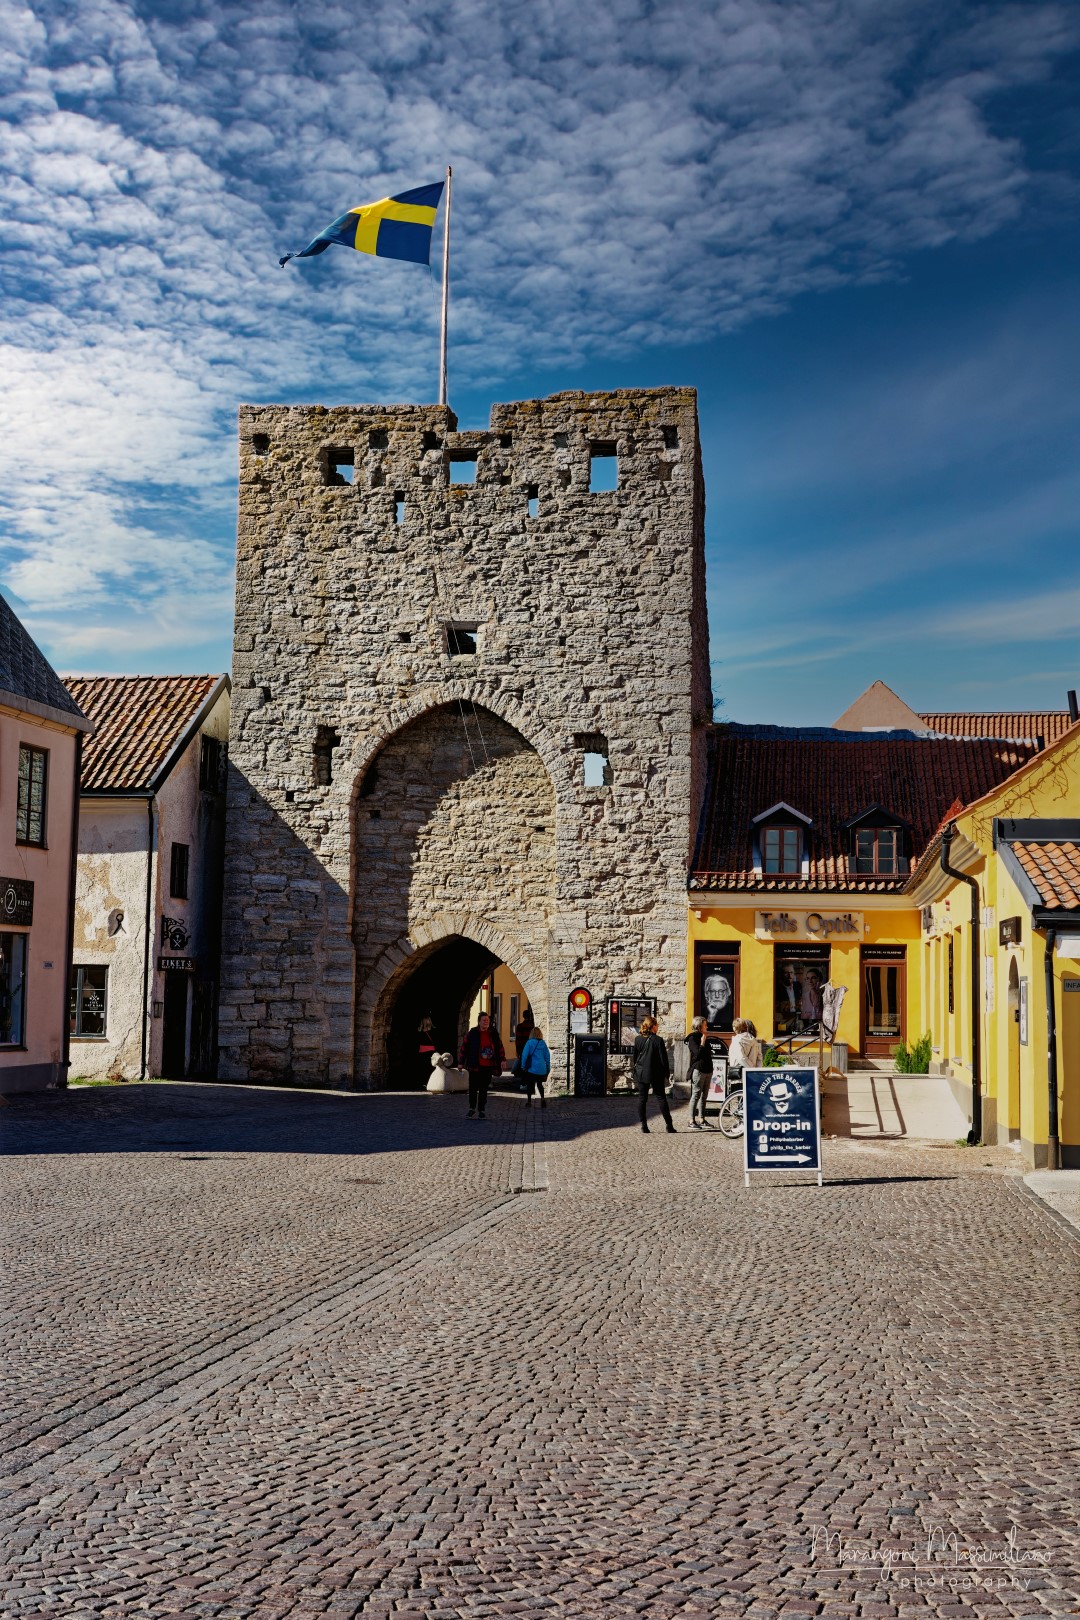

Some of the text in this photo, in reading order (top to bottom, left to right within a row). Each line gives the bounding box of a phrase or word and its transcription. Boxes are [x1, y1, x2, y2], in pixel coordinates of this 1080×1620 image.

[8, 892, 14, 910] 2
[760, 913, 860, 938] Tells Optik
[758, 1077, 772, 1094] PHILIP
[785, 1074, 803, 1094] BARBER
[752, 1119, 811, 1133] Drop-in
